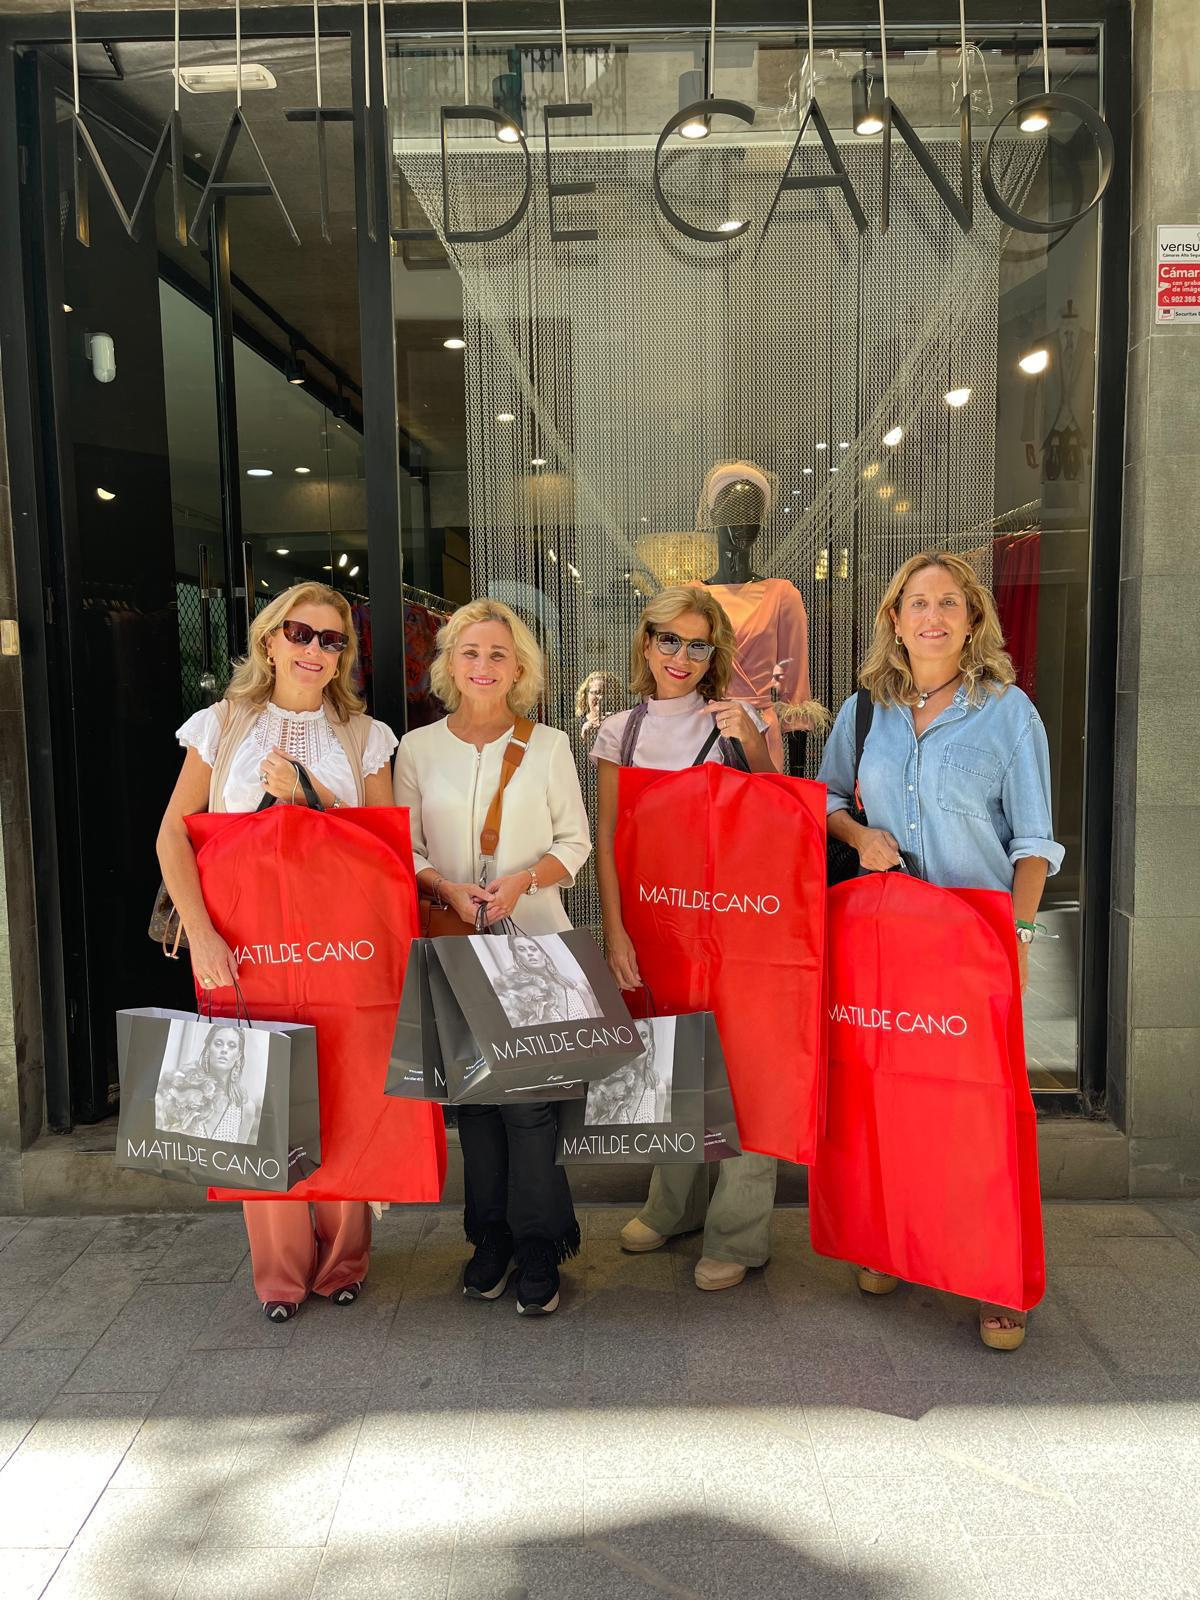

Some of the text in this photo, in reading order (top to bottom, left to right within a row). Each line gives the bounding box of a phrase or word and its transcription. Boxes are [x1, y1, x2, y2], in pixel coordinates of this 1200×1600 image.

[73, 92, 1115, 247] MATILDE CANO
[1160, 243, 1200, 252] verisu
[639, 884, 780, 915] MATILDE CANO
[306, 940, 375, 962] CANO
[895, 1011, 967, 1036] CANO
[491, 1025, 633, 1061] MATILDE CANO
[563, 1134, 630, 1155] MATILDE
[634, 1132, 696, 1154] CANO
[127, 1138, 208, 1167] MATILDE
[212, 1150, 280, 1180] CANO
